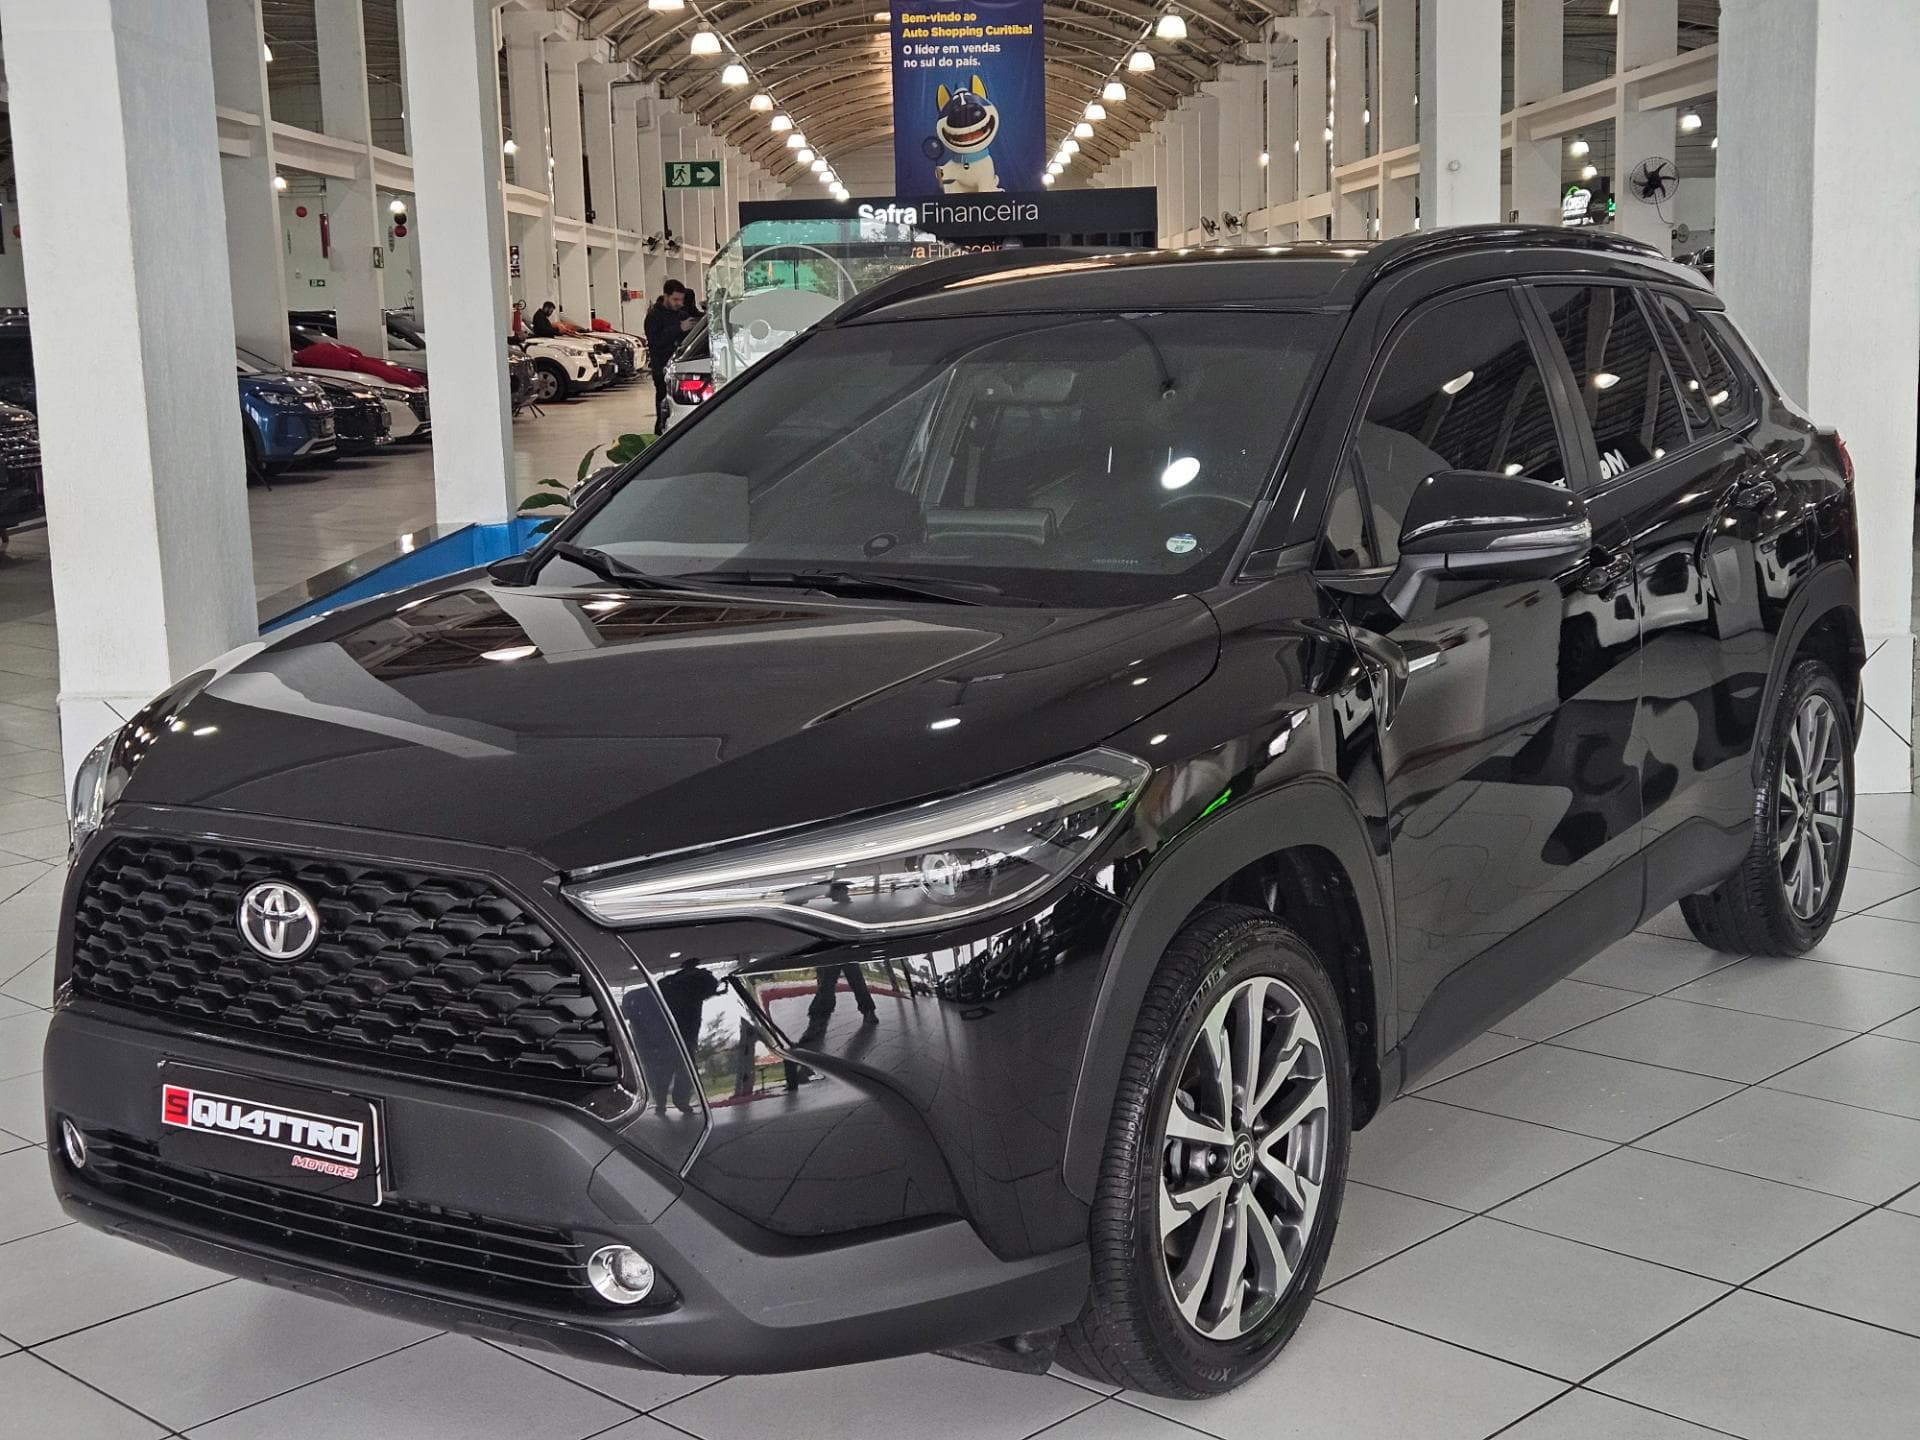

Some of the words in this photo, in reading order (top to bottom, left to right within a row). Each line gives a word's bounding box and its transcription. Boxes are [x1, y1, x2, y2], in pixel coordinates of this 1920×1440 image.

[901, 12, 961, 23] Bem-vindo
[963, 13, 977, 21] ao
[902, 28, 929, 37] Auto
[931, 26, 983, 38] Shopping
[985, 24, 1033, 35] Curitiba!
[903, 45, 912, 54] O
[915, 44, 939, 54] líder
[942, 45, 959, 54] em
[962, 42, 1001, 53] vendas
[903, 60, 917, 68] no
[920, 58, 935, 67] sul
[938, 57, 953, 66] do
[955, 55, 981, 68] país.
[858, 203, 917, 225] Safra
[922, 200, 1039, 224] Financeira
[291, 1155, 358, 1180] MOTORS
